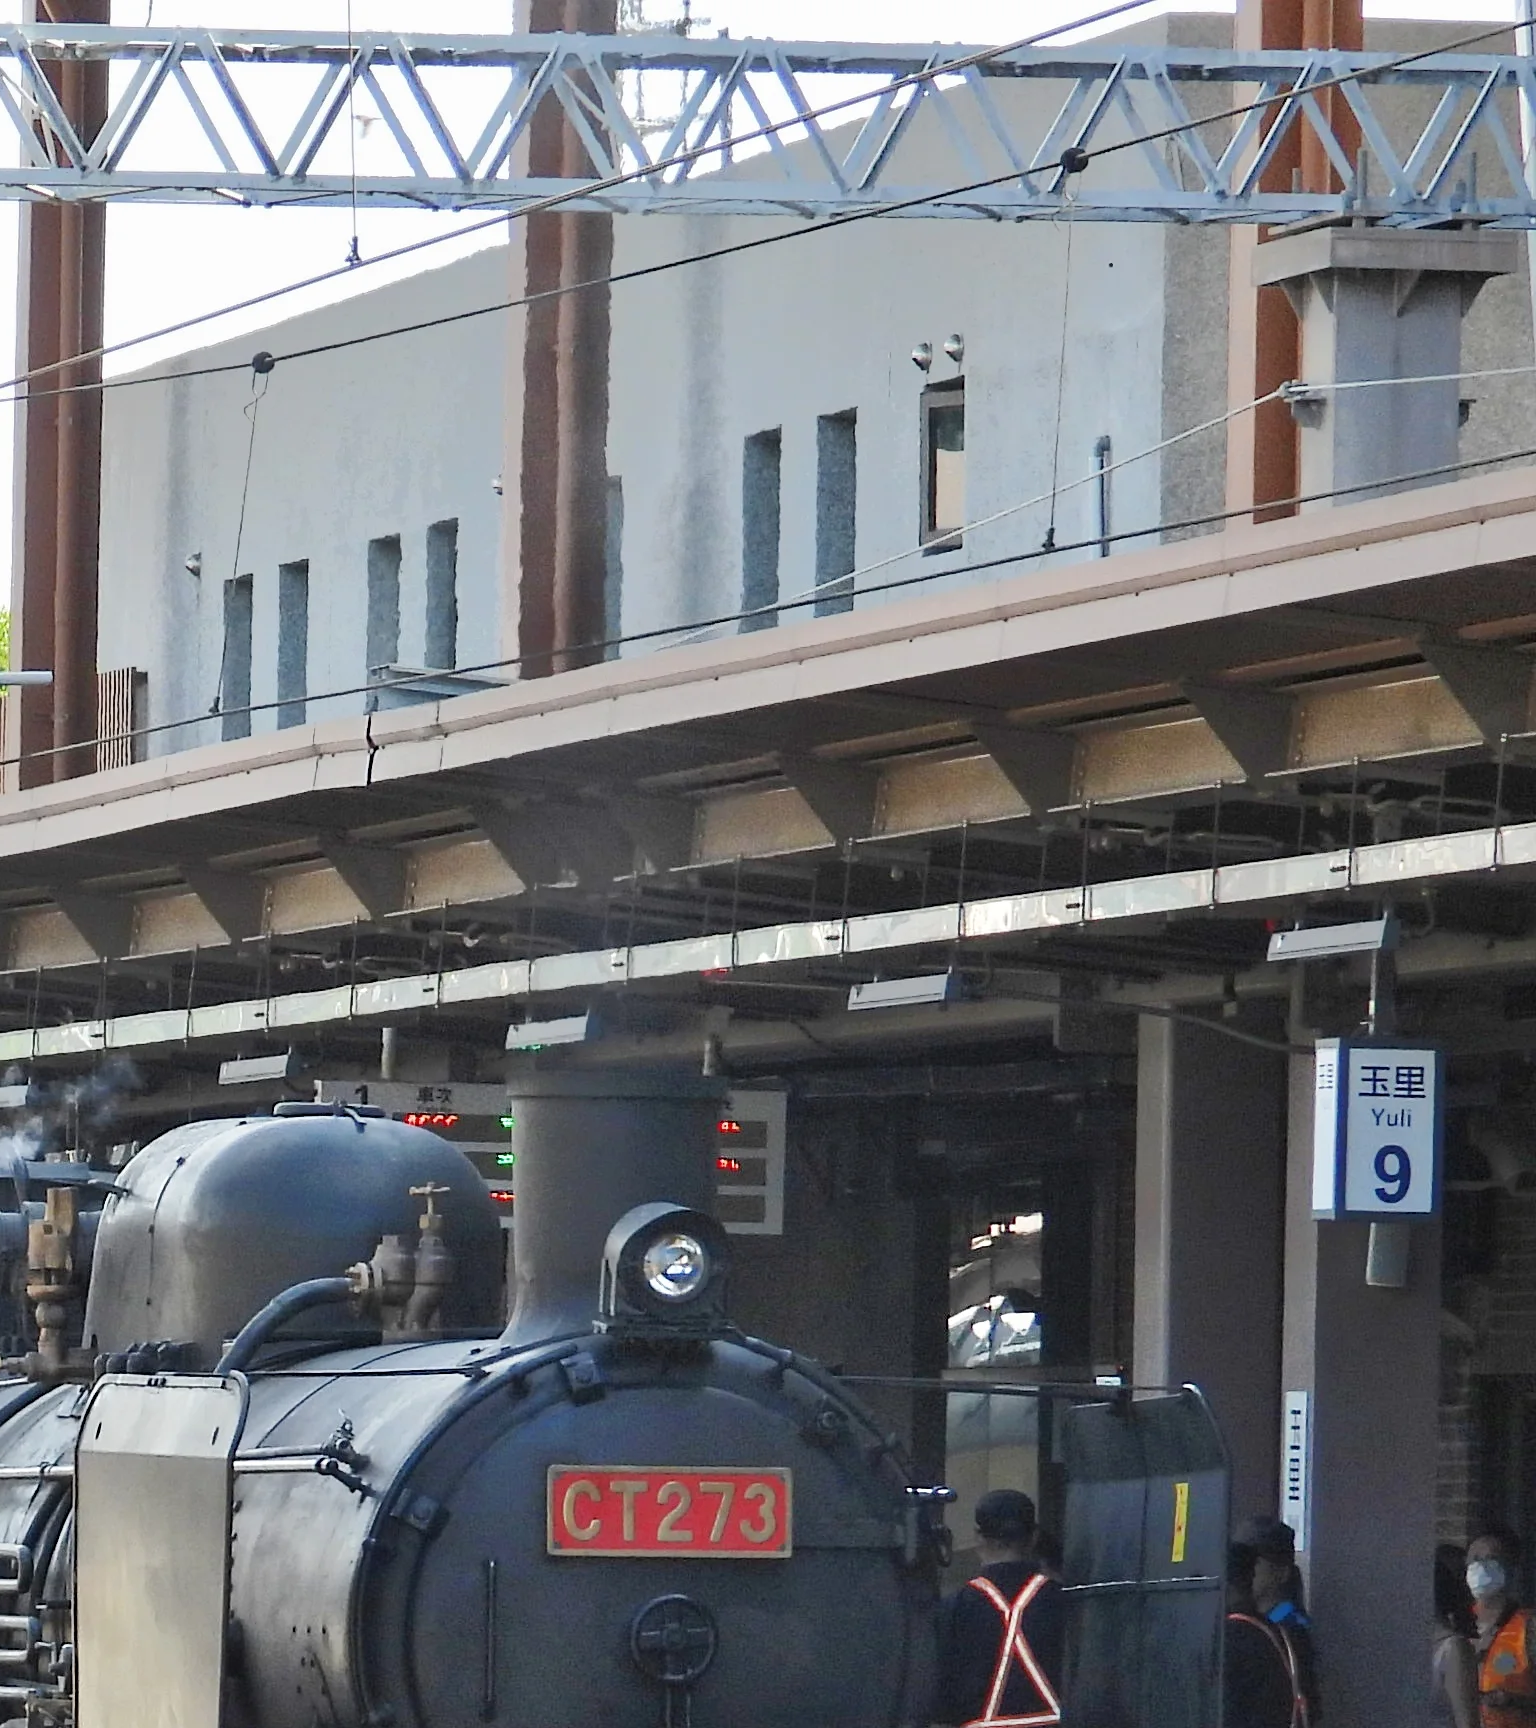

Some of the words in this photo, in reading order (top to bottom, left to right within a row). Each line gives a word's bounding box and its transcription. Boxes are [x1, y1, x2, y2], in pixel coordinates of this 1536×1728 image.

[1358, 1065, 1426, 1098] 玉里
[1371, 1107, 1412, 1127] Yuli
[1374, 1144, 1412, 1204] 9
[562, 1479, 777, 1544] CT273
